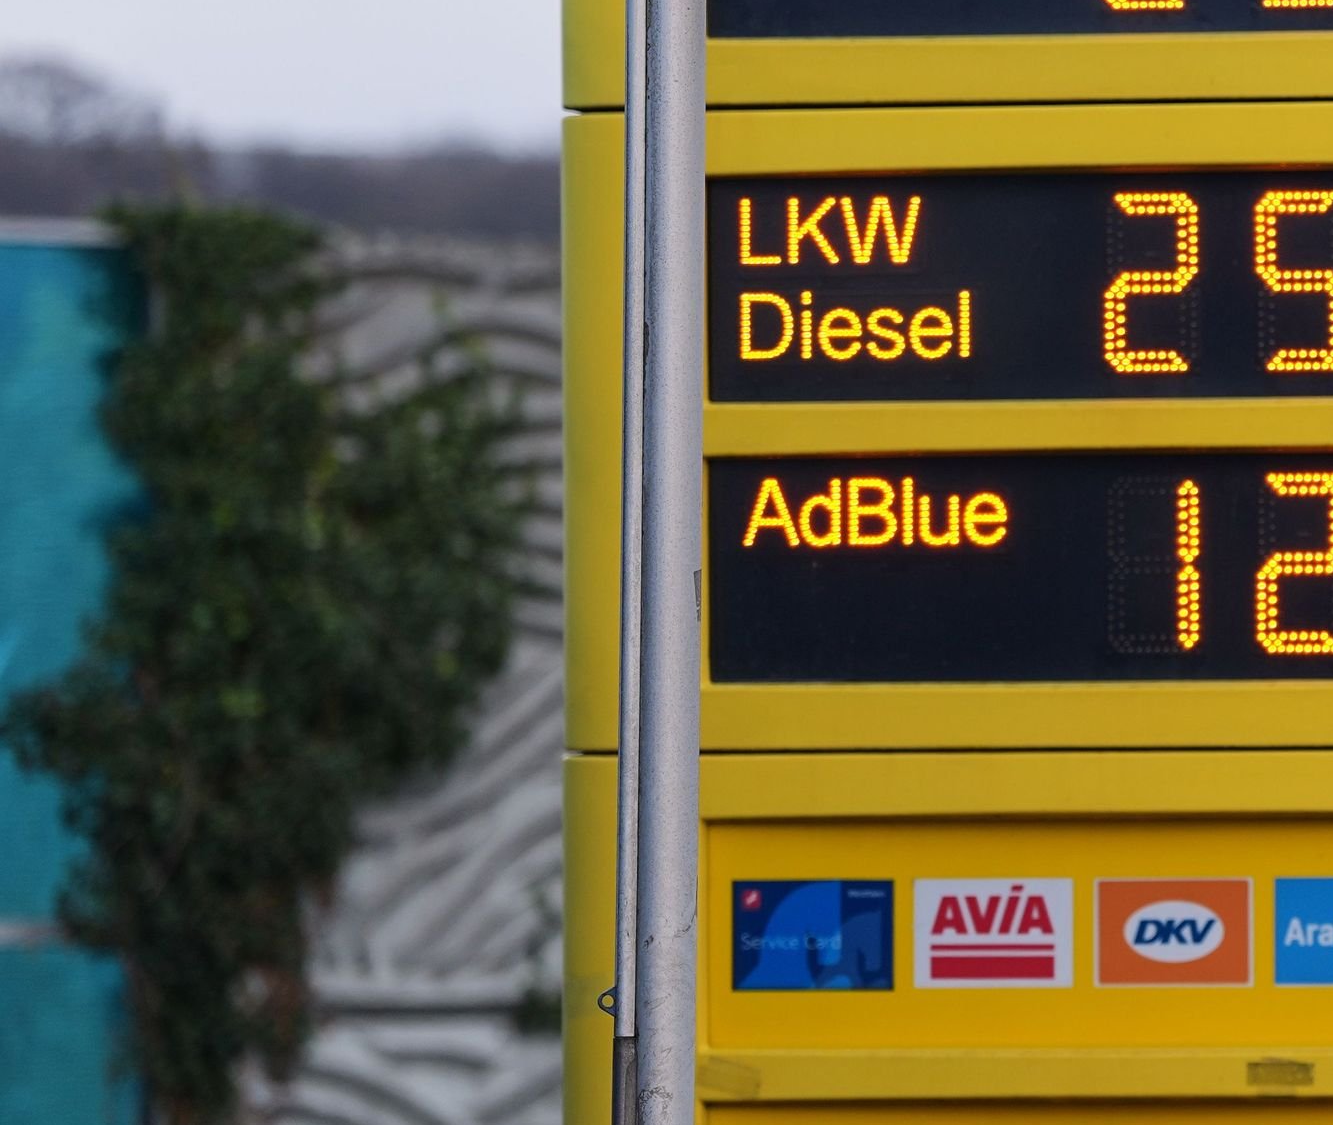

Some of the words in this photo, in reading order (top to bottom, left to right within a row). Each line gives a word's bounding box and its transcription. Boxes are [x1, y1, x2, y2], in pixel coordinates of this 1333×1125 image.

[739, 195, 922, 266] LKW
[739, 289, 971, 361] Diesel
[742, 476, 1009, 548] AdBlue
[931, 884, 1055, 935] AVIA
[1133, 919, 1216, 945] DKV
[741, 932, 799, 951] Service
[805, 930, 842, 951] Card
